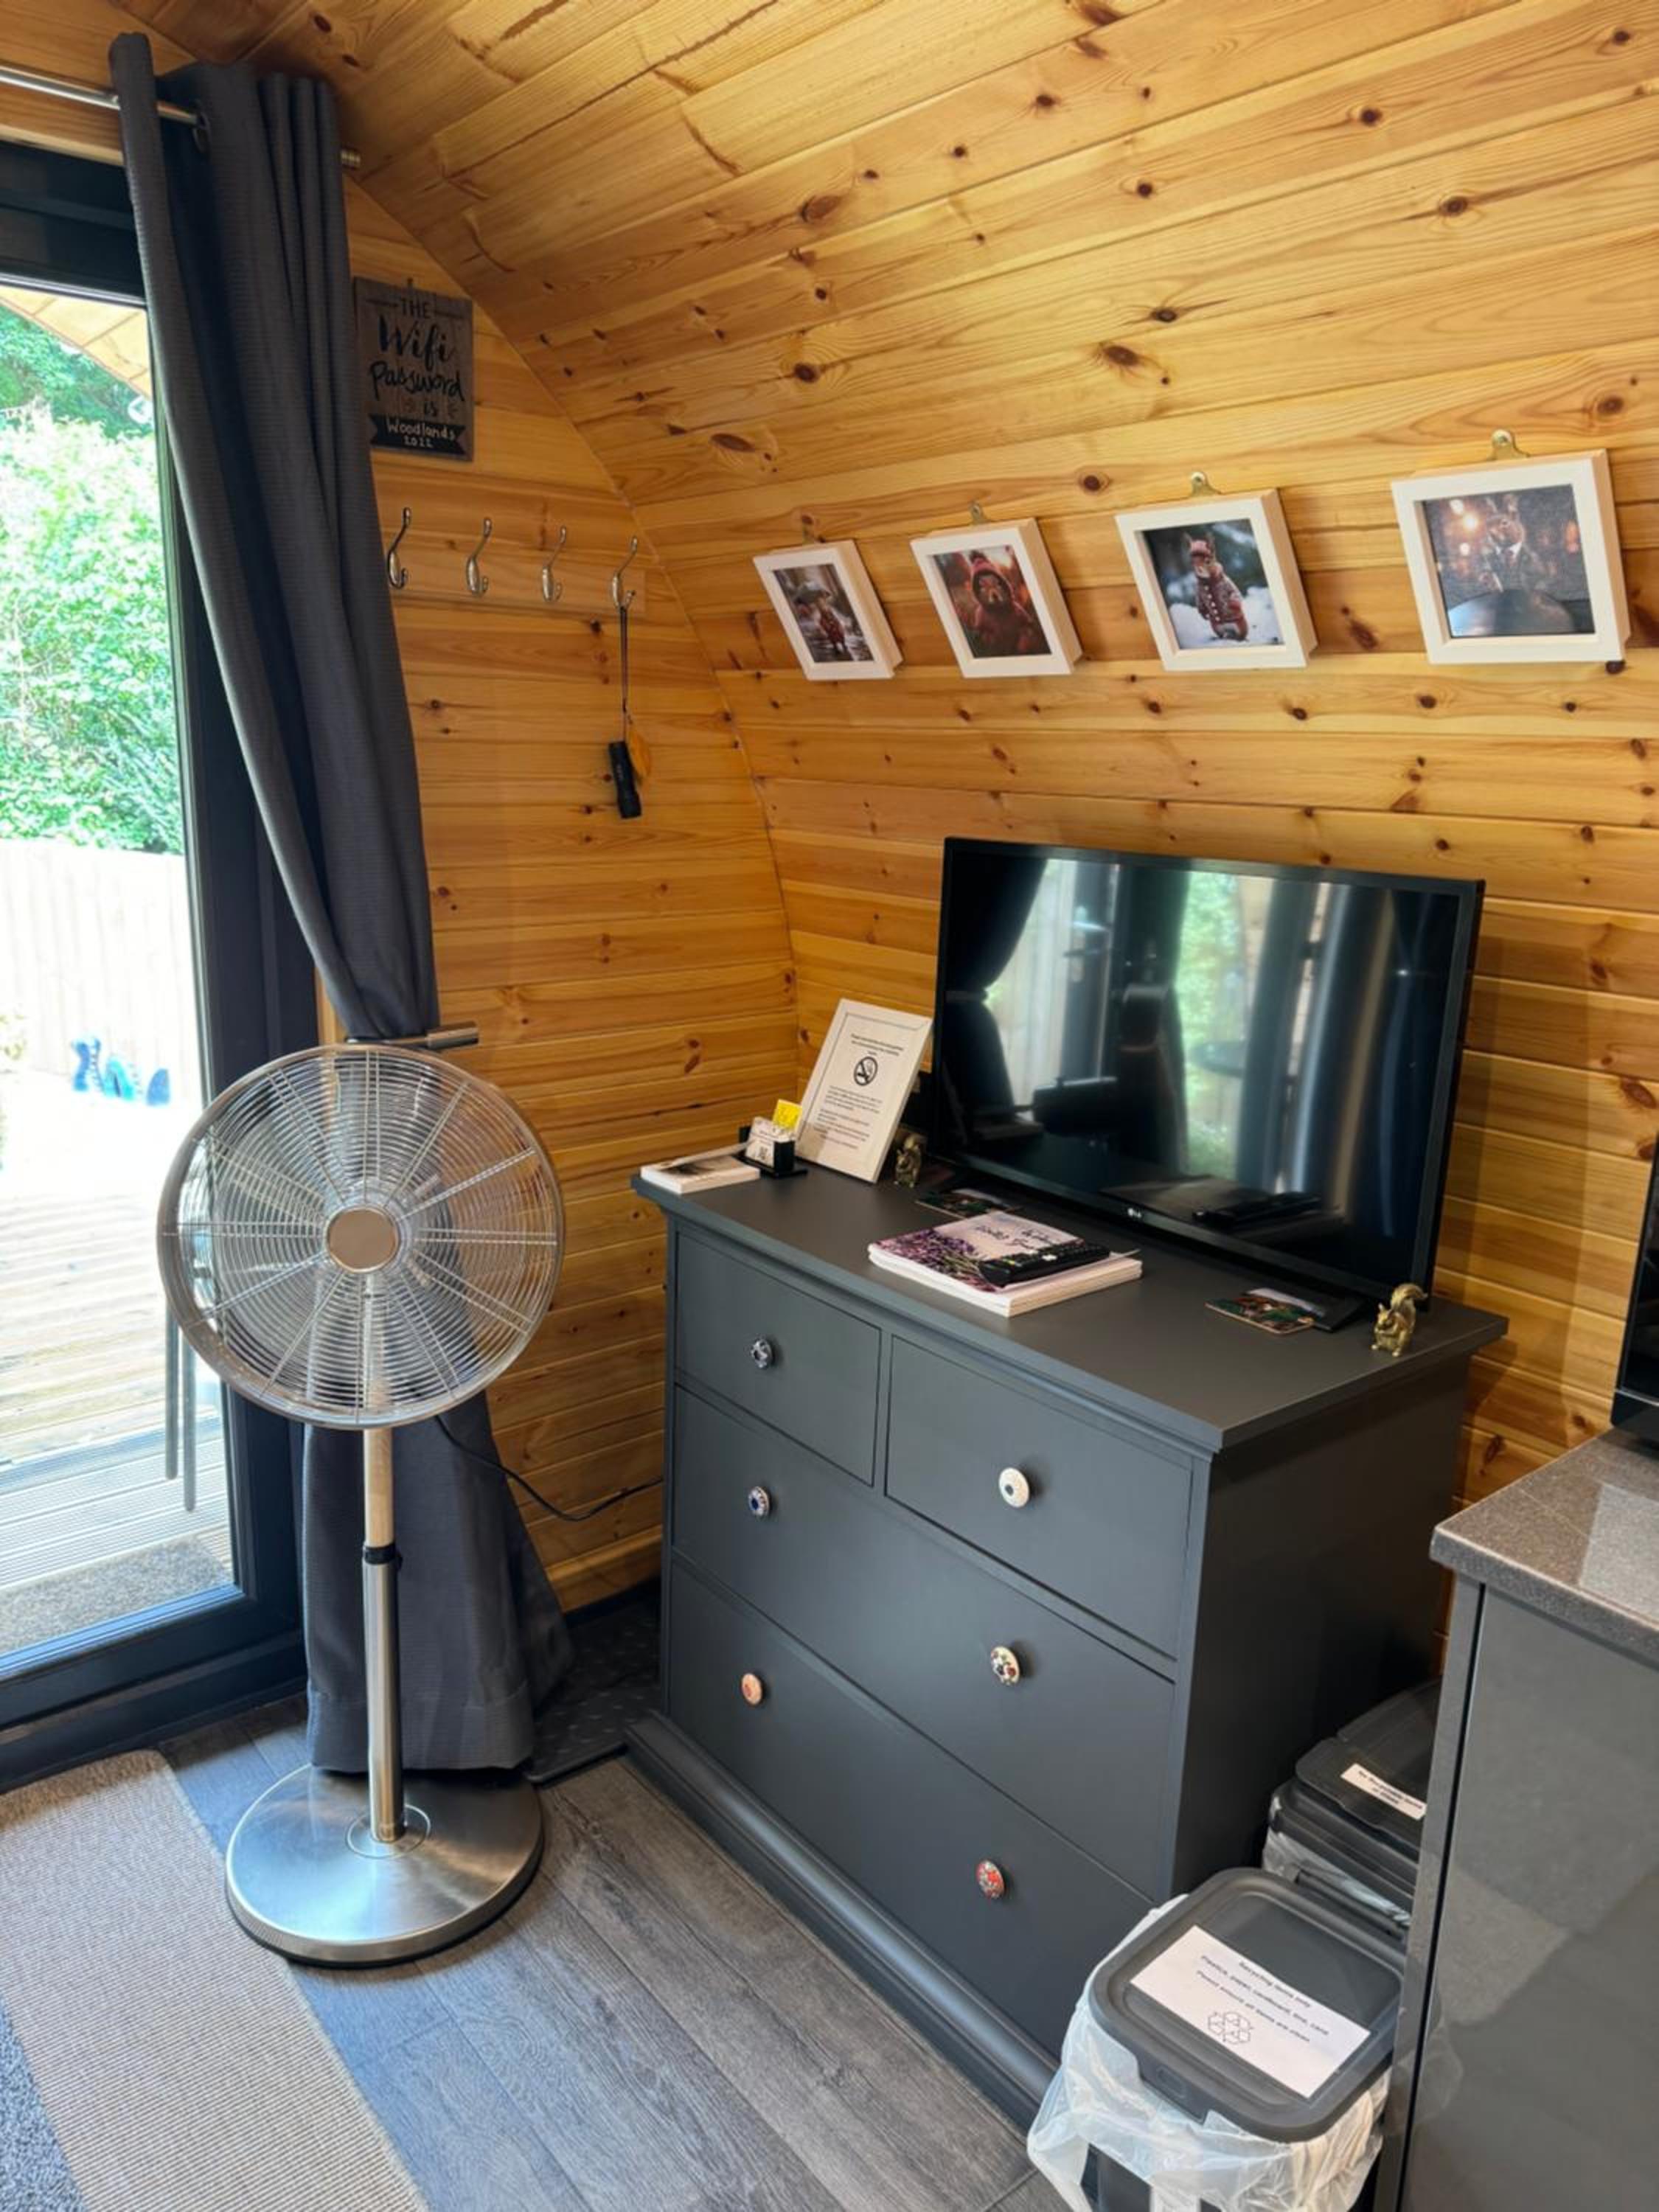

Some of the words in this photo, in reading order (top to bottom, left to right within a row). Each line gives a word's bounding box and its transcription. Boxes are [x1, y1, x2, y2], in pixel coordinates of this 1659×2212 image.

[400, 298, 429, 319] THE
[378, 314, 454, 369] Wifi
[369, 361, 465, 401] Password
[386, 416, 455, 441] Woodlands
